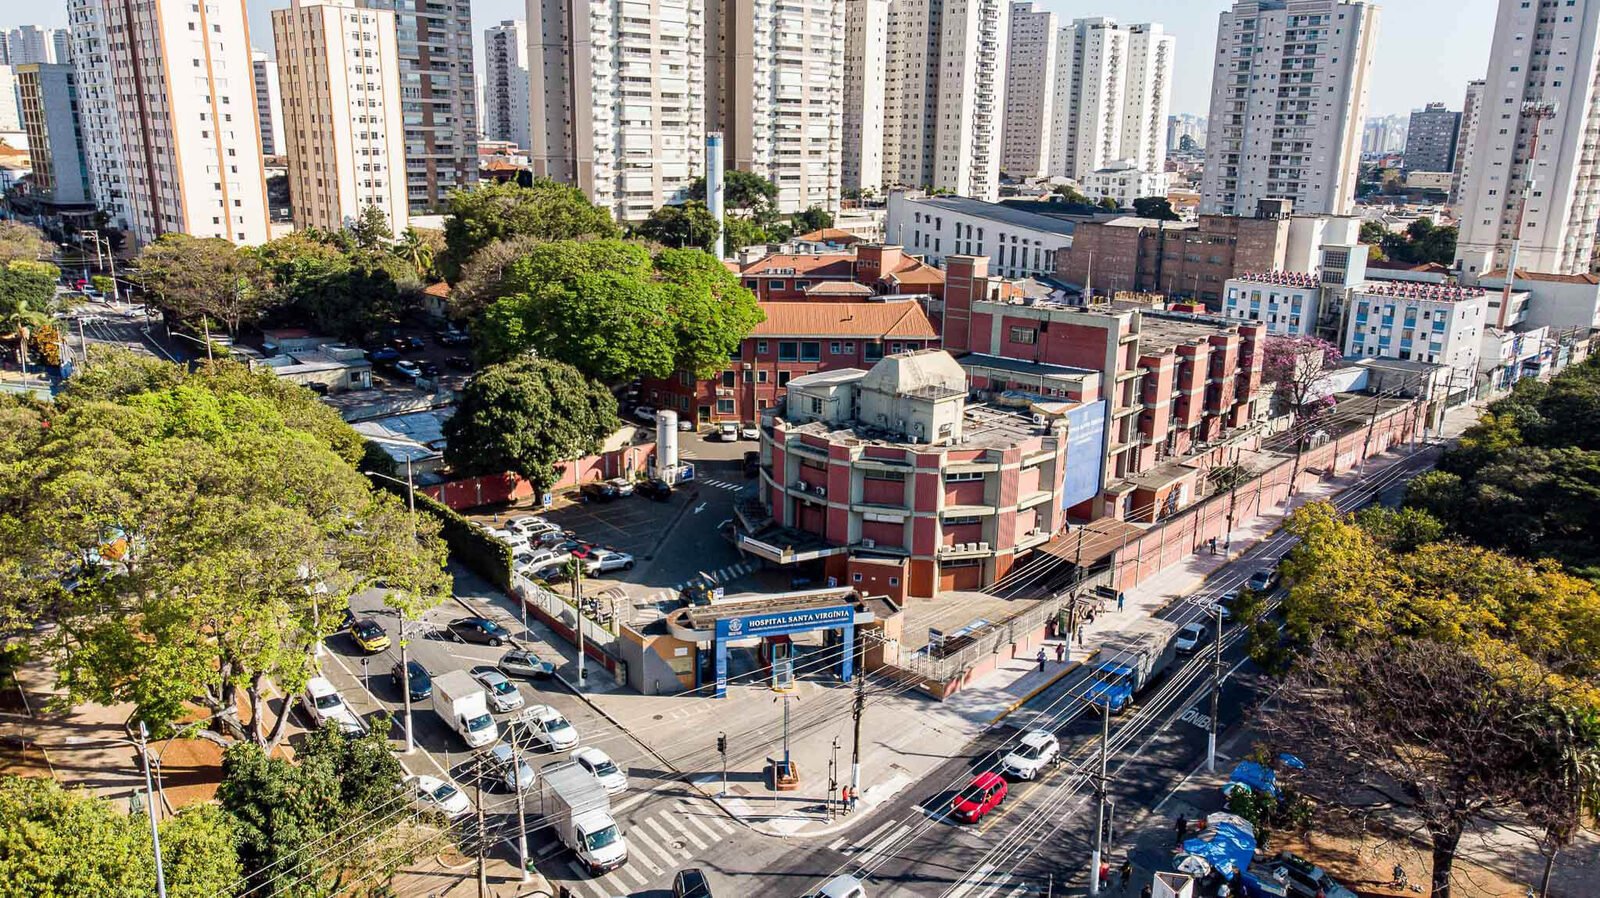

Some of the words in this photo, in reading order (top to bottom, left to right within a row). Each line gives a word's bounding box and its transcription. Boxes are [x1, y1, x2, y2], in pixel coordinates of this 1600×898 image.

[749, 617, 787, 627] HOSPITAL
[788, 613, 814, 623] SANTA
[815, 609, 850, 620] VIRGÍNIA
